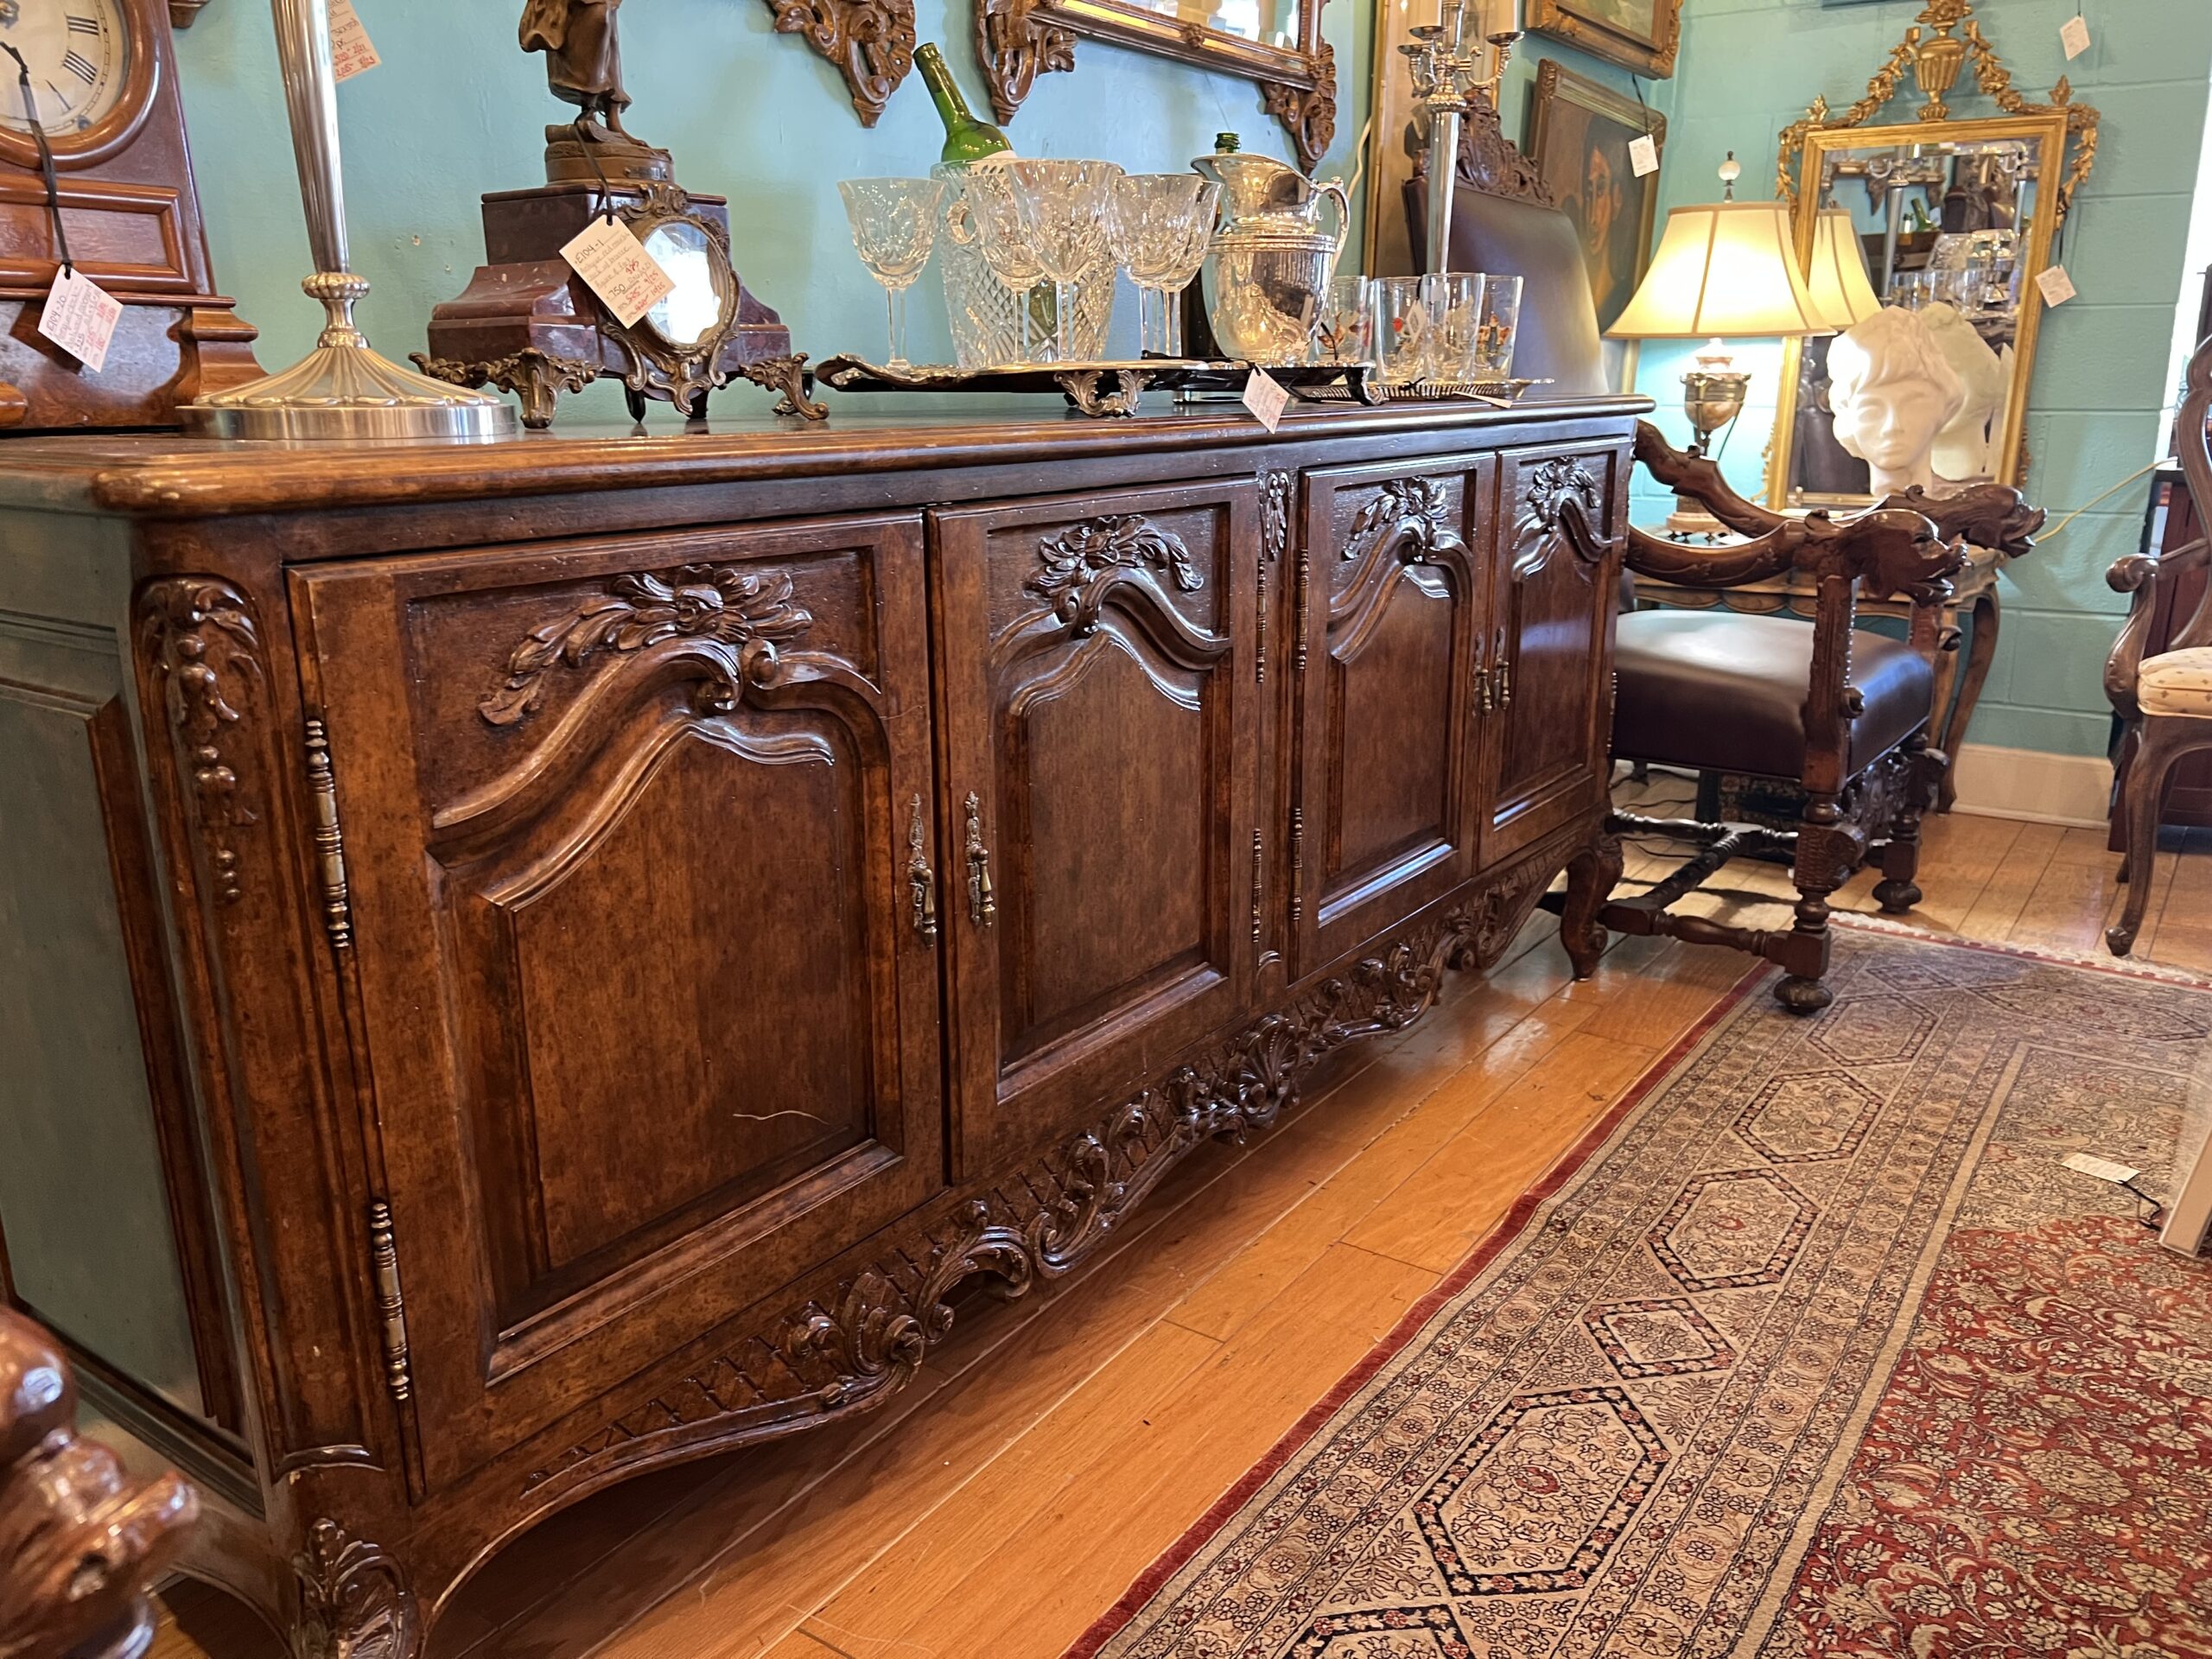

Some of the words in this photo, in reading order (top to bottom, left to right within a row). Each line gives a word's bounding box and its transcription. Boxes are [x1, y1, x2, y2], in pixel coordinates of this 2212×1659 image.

[575, 239, 604, 264] E104-1
[607, 283, 626, 298] 750
[47, 296, 67, 332] E104-20
